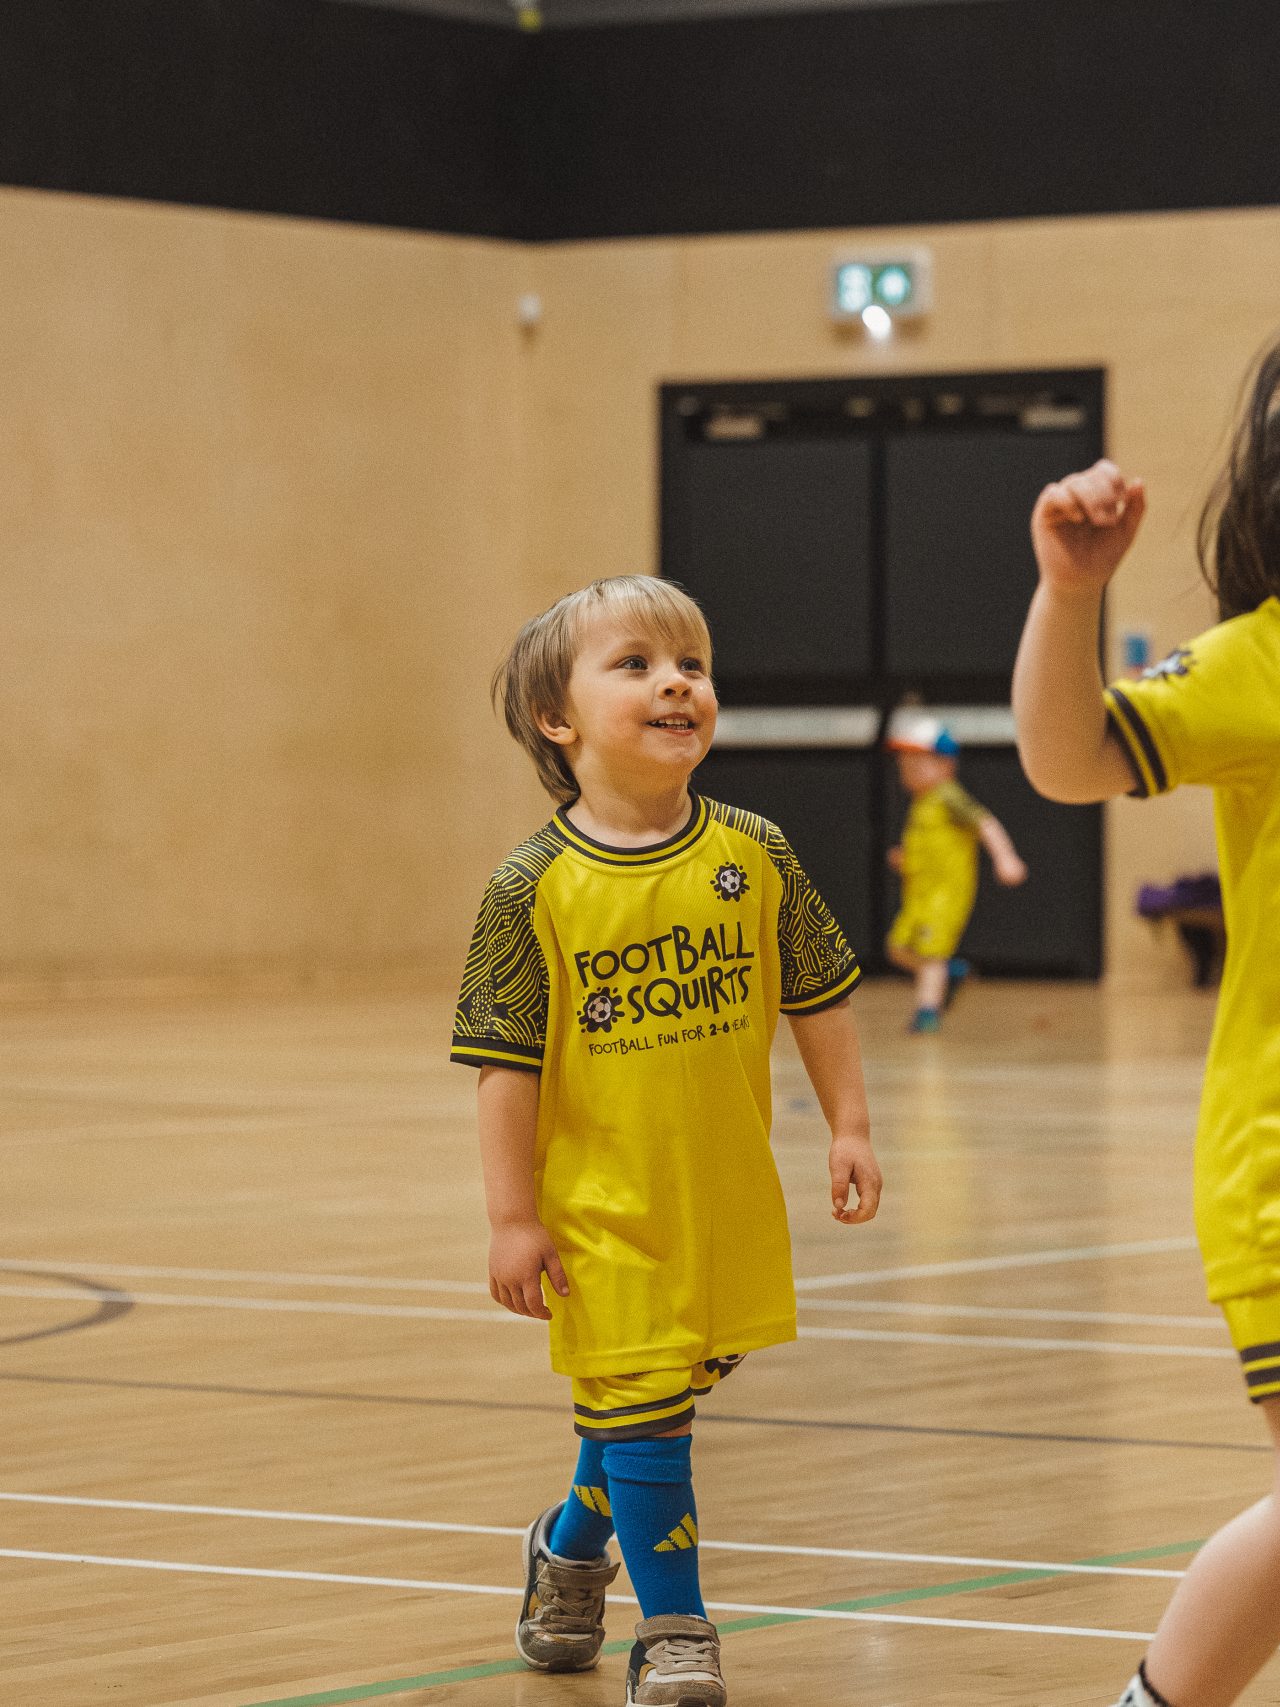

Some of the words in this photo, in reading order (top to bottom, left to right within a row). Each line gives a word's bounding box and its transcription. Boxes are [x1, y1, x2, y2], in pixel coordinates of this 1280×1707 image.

[574, 922, 754, 988] FOOTBALL
[627, 965, 752, 1024] SQUIRTS
[589, 1038, 654, 1056] FOOTBALL
[658, 1032, 679, 1046] FUN
[682, 1025, 705, 1043] FOR
[709, 1021, 730, 1036] 2-6
